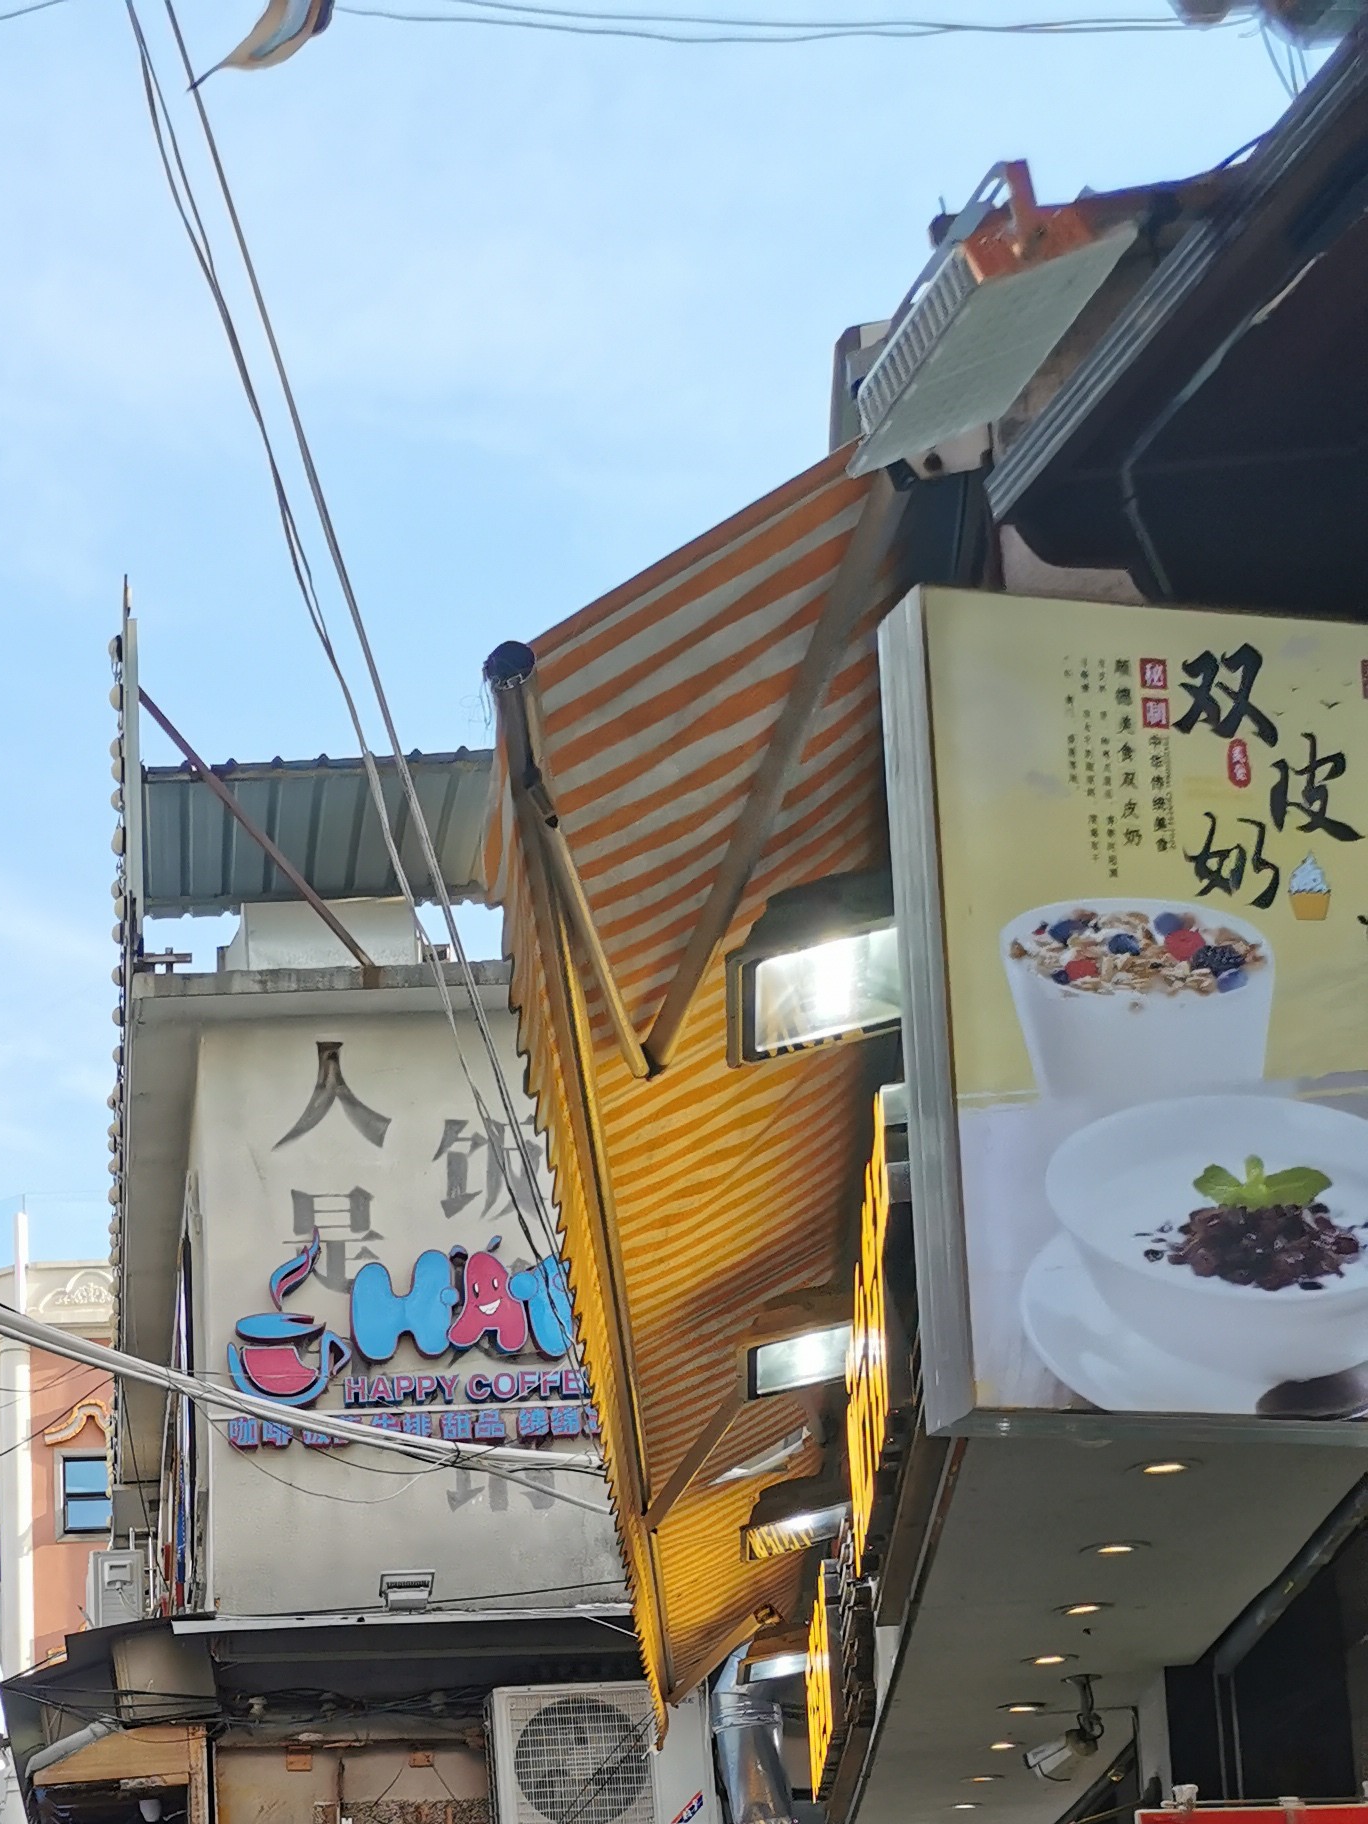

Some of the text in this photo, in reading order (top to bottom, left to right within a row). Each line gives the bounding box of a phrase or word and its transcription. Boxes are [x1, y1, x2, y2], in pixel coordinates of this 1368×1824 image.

[344, 1368, 592, 1406] HAPPY COFFE
[228, 1416, 294, 1449] 咖啡
[440, 1409, 506, 1443] 甜品
